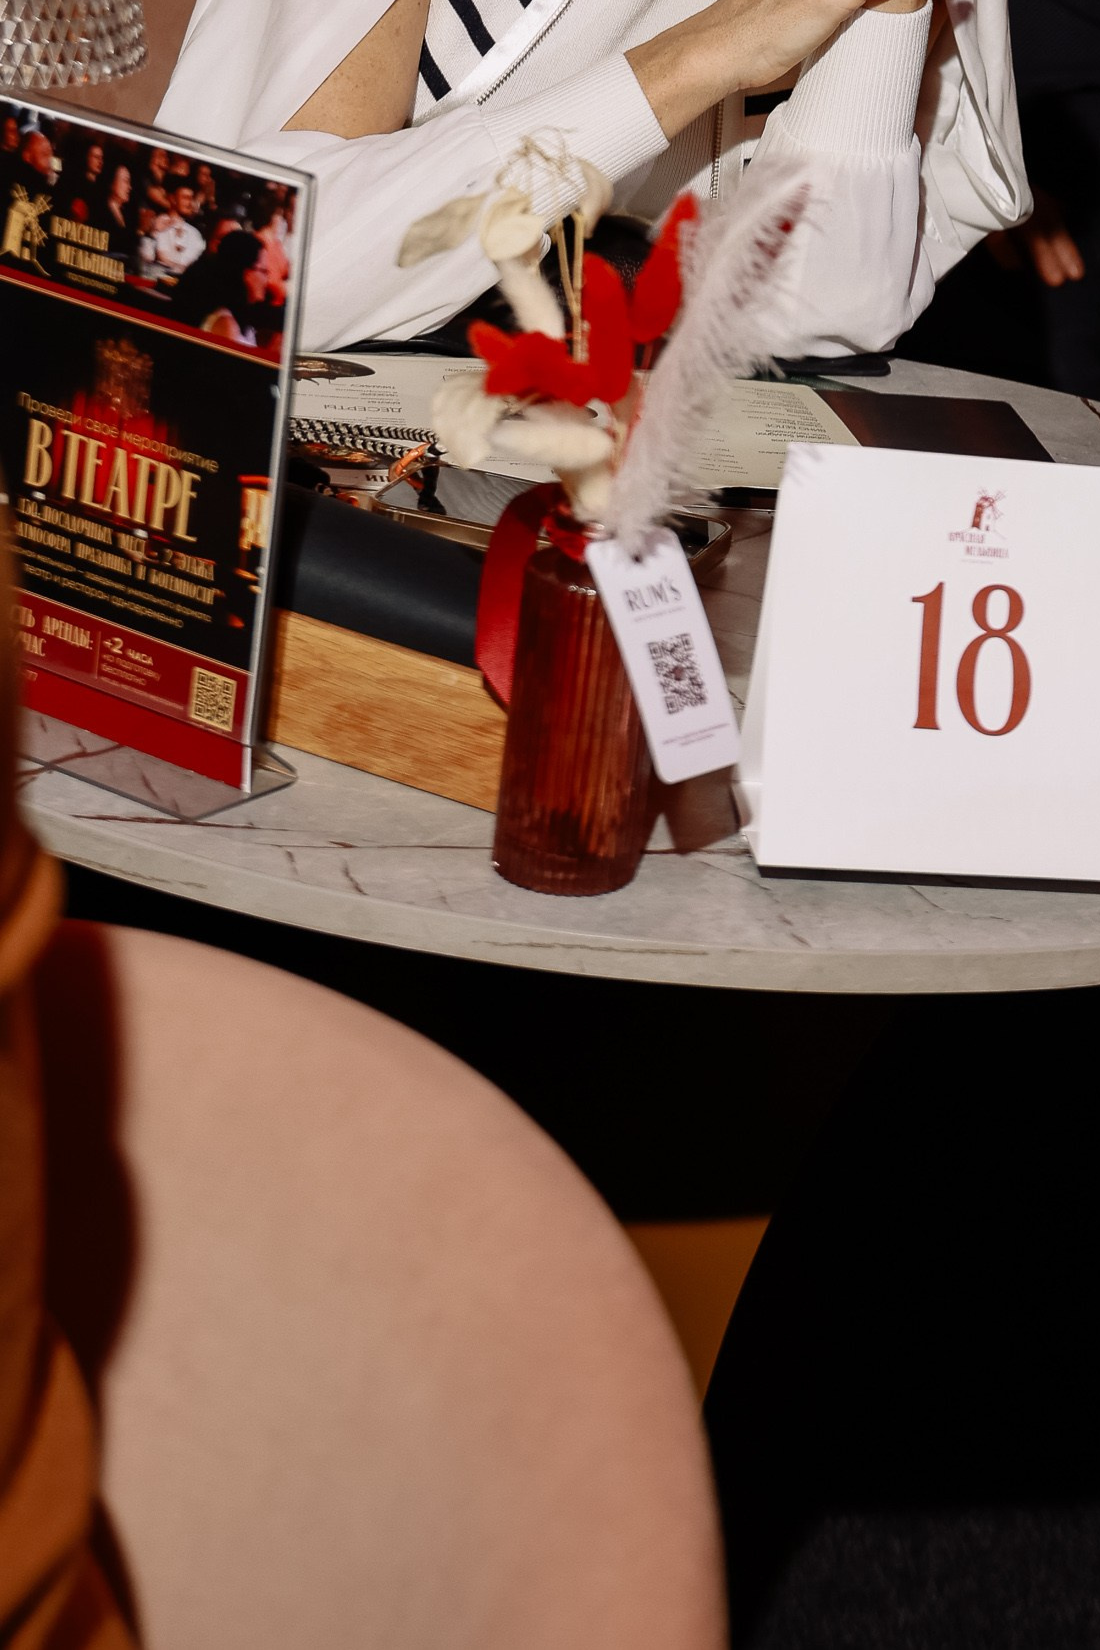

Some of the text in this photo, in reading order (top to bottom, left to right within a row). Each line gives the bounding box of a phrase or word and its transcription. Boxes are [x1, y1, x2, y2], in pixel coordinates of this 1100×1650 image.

[17, 391, 83, 425] Проведи
[121, 430, 220, 474] мероприятие
[323, 404, 402, 413] ДЕСЕРТЫ
[23, 418, 201, 543] В ТЕАТРЕ
[911, 581, 1032, 736] 18
